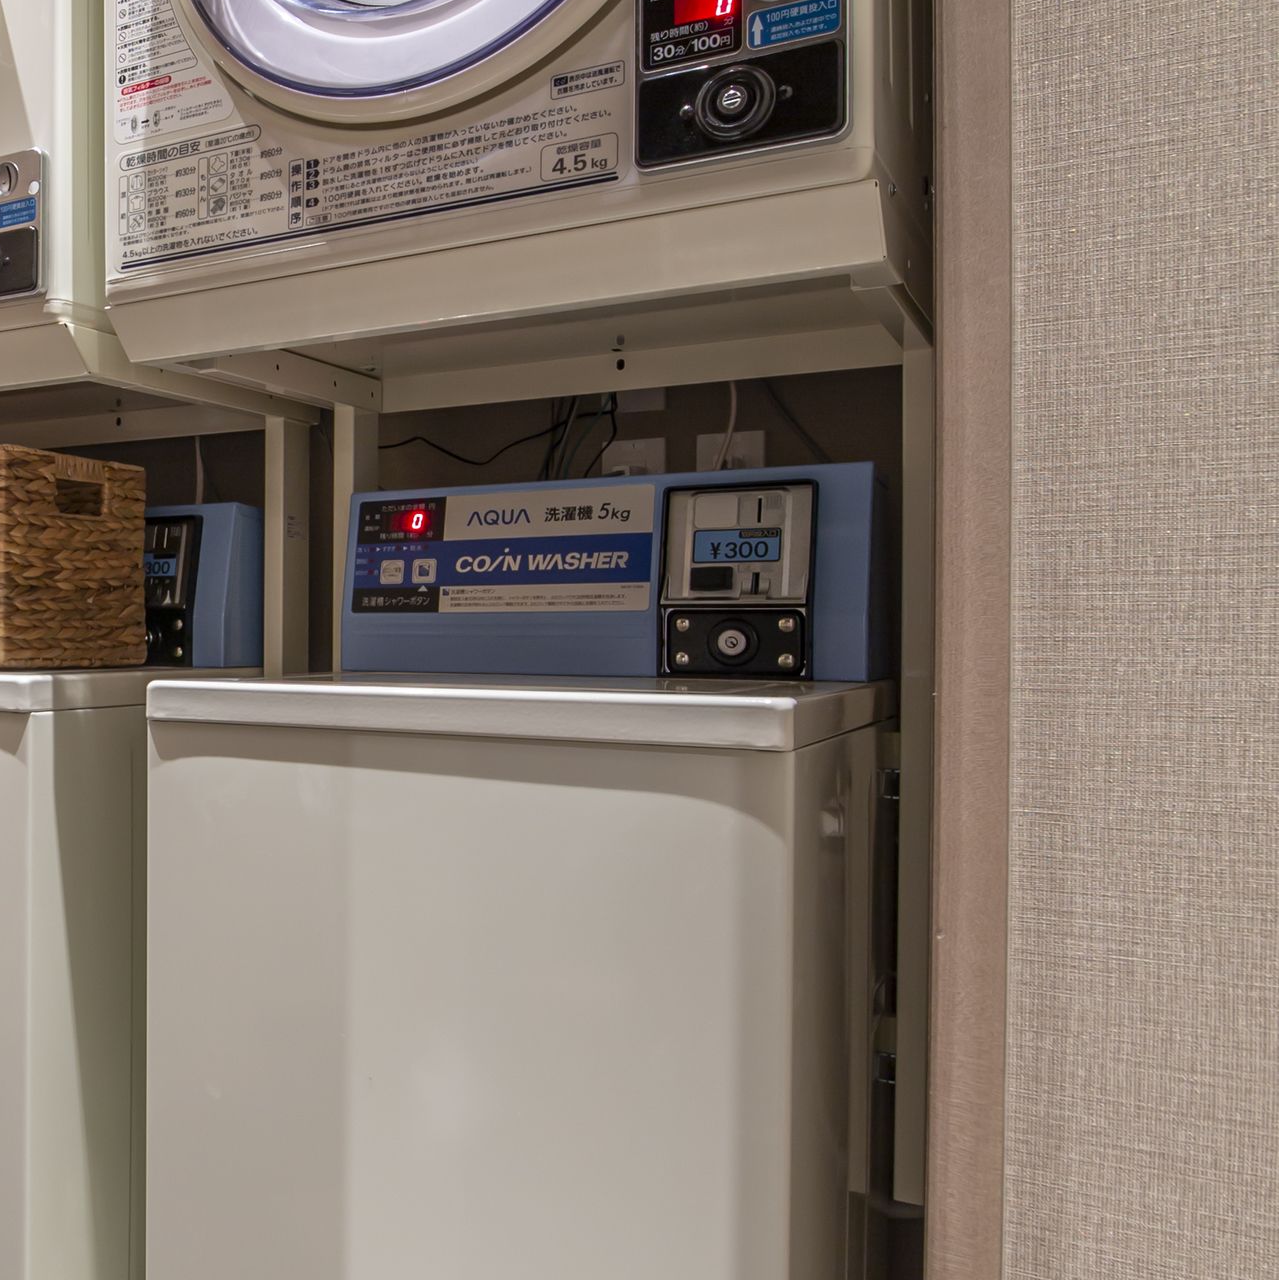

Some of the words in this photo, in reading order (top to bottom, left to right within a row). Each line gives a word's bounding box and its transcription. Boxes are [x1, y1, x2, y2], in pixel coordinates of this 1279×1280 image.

[653, 30, 730, 62] 30分/100円
[126, 140, 200, 168] 乾燥時間の目安
[556, 137, 602, 156] 乾燥容量
[551, 153, 586, 176] 4.5
[591, 155, 607, 171] kg
[411, 513, 424, 530] 0
[467, 509, 531, 527] AQUA
[544, 505, 594, 523] 洗濯機
[598, 503, 631, 522] 5kg
[528, 550, 630, 571] WASHER
[710, 541, 769, 560] ¥300
